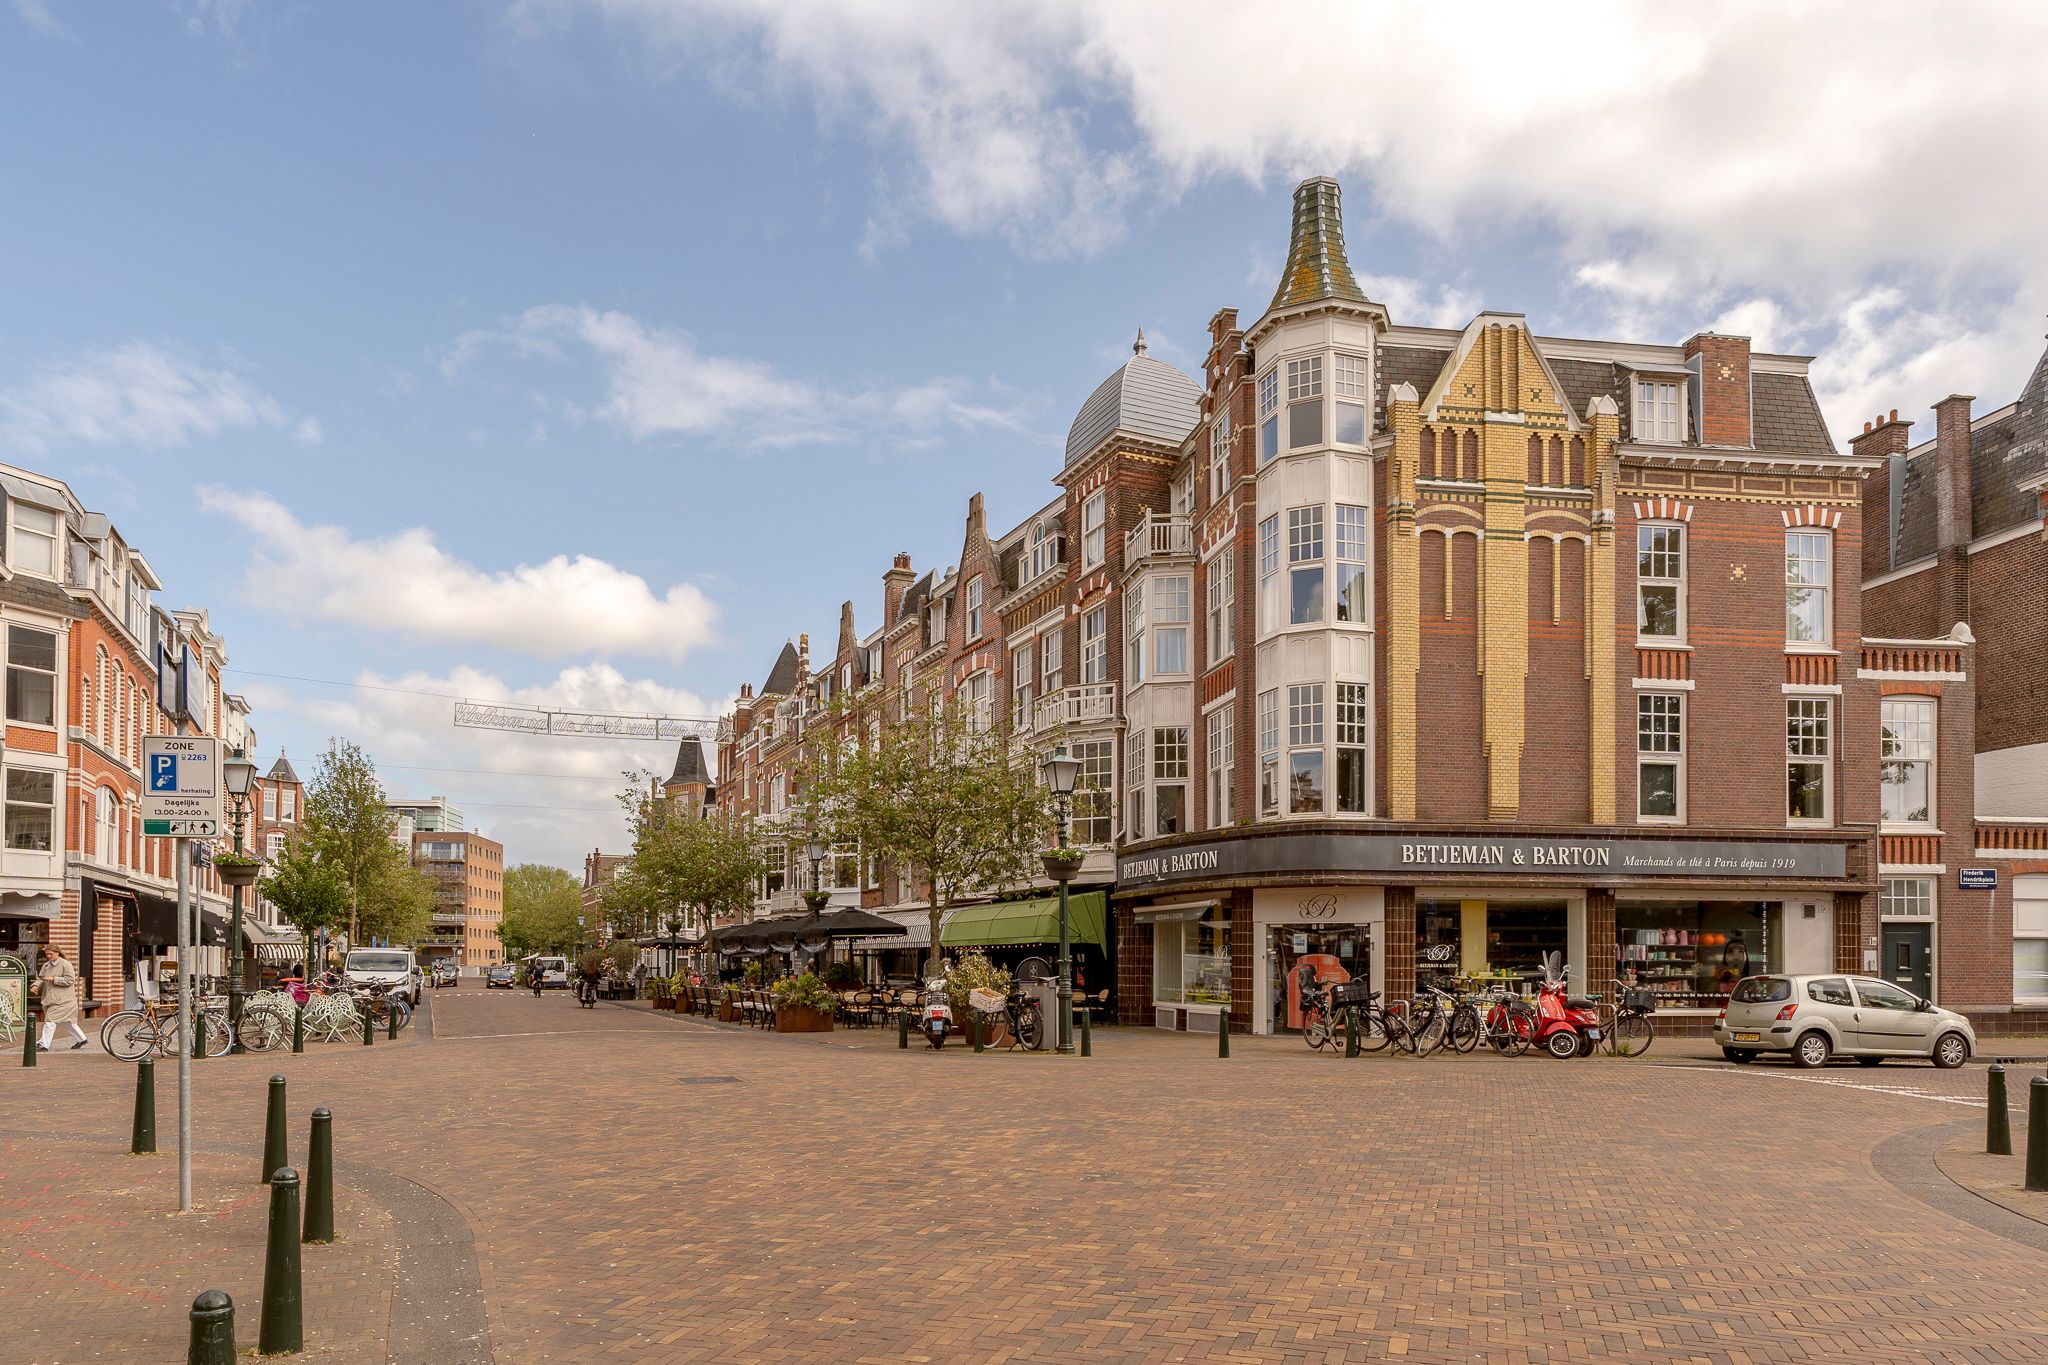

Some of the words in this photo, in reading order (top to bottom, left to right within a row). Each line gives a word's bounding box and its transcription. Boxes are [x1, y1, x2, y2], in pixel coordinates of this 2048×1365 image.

[165, 742, 194, 751] ZONE
[158, 756, 172, 774] P
[1123, 857, 1159, 879] BETJEMAN
[1161, 858, 1169, 874] &
[1171, 850, 1218, 872] BARTON
[1401, 844, 1505, 865] BETJEMAN
[1512, 848, 1526, 865] &
[1532, 846, 1610, 867] BARTON
[1623, 855, 1674, 868] Marchands
[1676, 856, 1687, 867] de
[1689, 856, 1703, 867] thé
[1704, 856, 1711, 867] à
[1713, 857, 1738, 868] Paris
[1740, 857, 1768, 871] depuis
[1771, 858, 1797, 869] 1919
